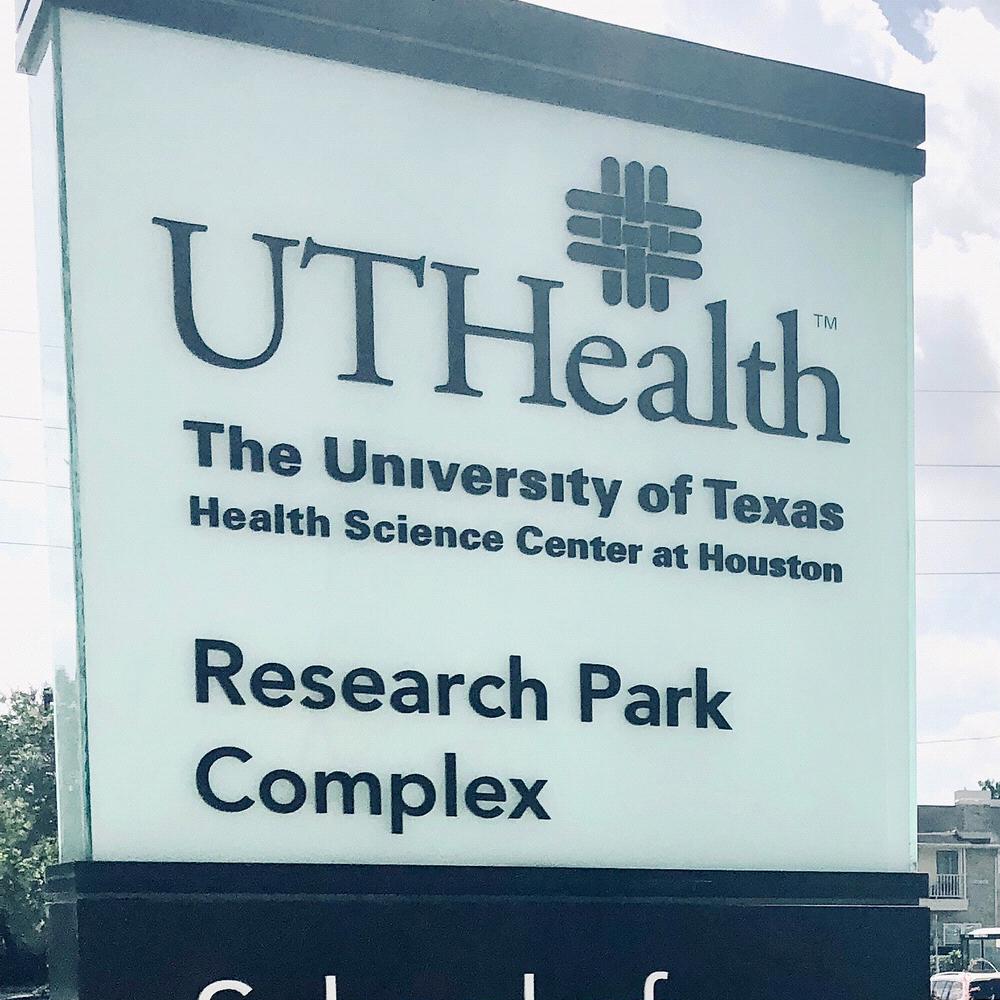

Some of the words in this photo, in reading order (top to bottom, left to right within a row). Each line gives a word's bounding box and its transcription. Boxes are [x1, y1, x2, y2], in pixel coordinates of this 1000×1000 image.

[152, 217, 850, 444] UTHealth
[183, 420, 302, 479] The
[324, 436, 622, 519] University
[637, 473, 694, 516] of
[703, 478, 844, 532] Texas
[190, 495, 331, 538] Health
[344, 509, 504, 553] Science
[516, 525, 643, 568] Center
[652, 544, 689, 570] at
[699, 542, 843, 584] Houston
[195, 638, 548, 722] Research
[580, 663, 733, 731] Park
[195, 745, 552, 835] Complex
